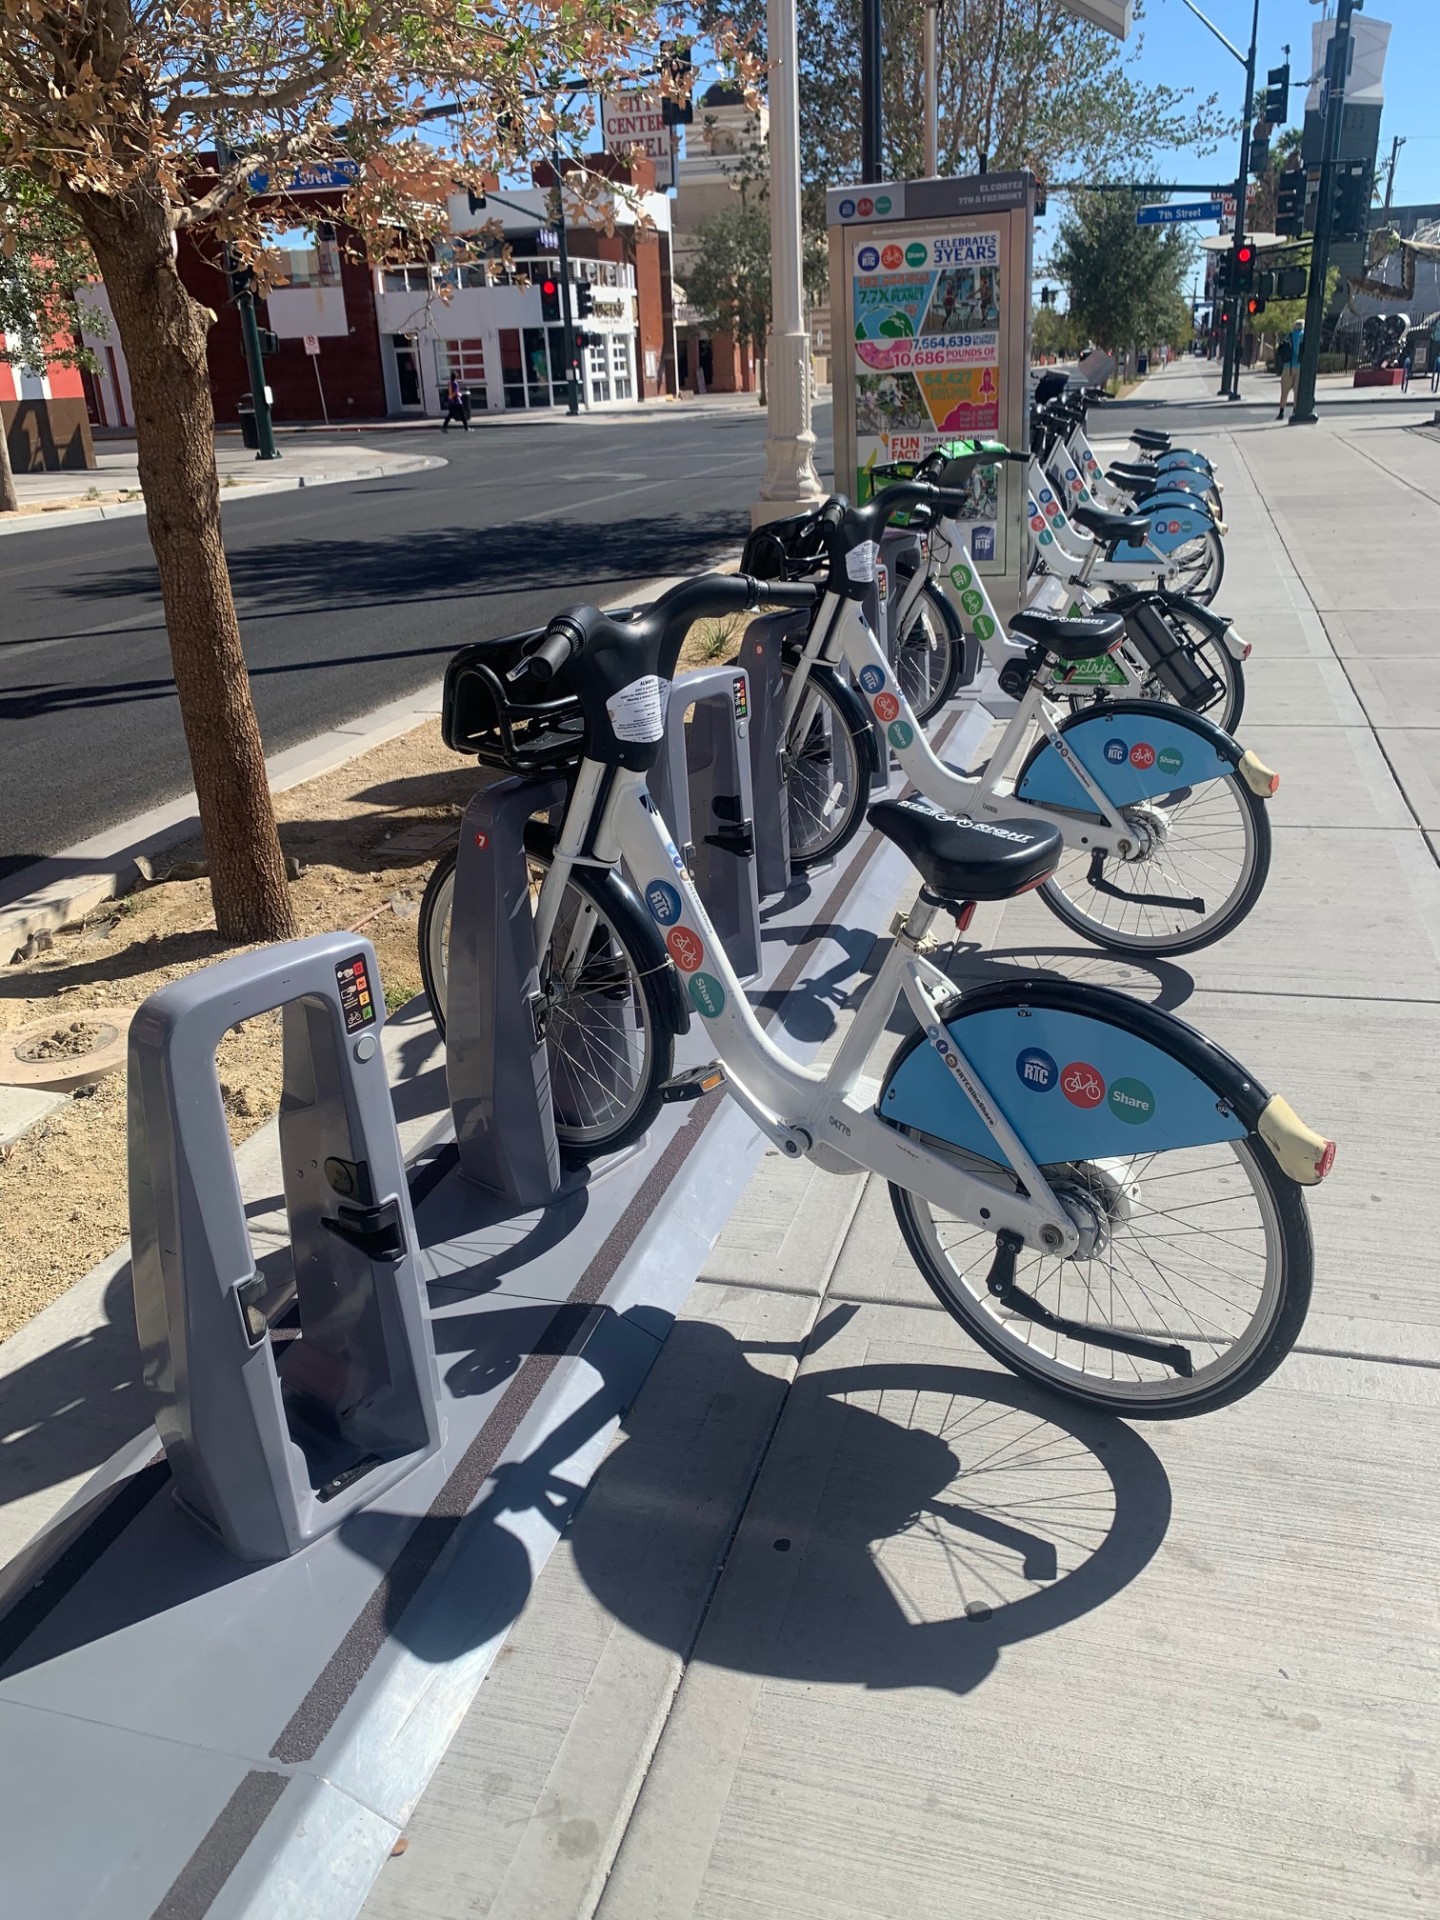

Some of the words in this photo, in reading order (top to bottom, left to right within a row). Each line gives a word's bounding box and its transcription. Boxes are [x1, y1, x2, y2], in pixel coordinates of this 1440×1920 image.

[619, 94, 652, 113] ITY
[607, 113, 666, 135] CENTER
[609, 137, 669, 158] MOEL
[299, 169, 333, 185] Street
[980, 184, 989, 192] EL
[991, 181, 1023, 191] CORTEZ
[982, 192, 1023, 203] FREMONT
[1158, 210, 1173, 220] 7th
[1176, 208, 1202, 219] Street
[934, 235, 996, 249] CELEBRATES
[862, 256, 875, 266] RTC
[912, 335, 972, 350] 7,664,639
[894, 351, 945, 367] 10,686
[946, 348, 983, 359] POUNDS
[984, 347, 996, 356] OF
[891, 437, 920, 450] FUN
[891, 450, 920, 460] FACT:
[974, 538, 991, 549] RTC
[953, 571, 964, 587] RTC
[977, 618, 989, 638] Share
[863, 672, 876, 689] RTC
[892, 723, 907, 746] Share
[1108, 748, 1123, 760] RTC
[1159, 755, 1181, 766] Share
[478, 835, 485, 847] 7
[650, 889, 669, 918] RTC
[695, 977, 716, 1014] Share
[1024, 1064, 1049, 1085] RTC
[1112, 1090, 1150, 1111] Share
